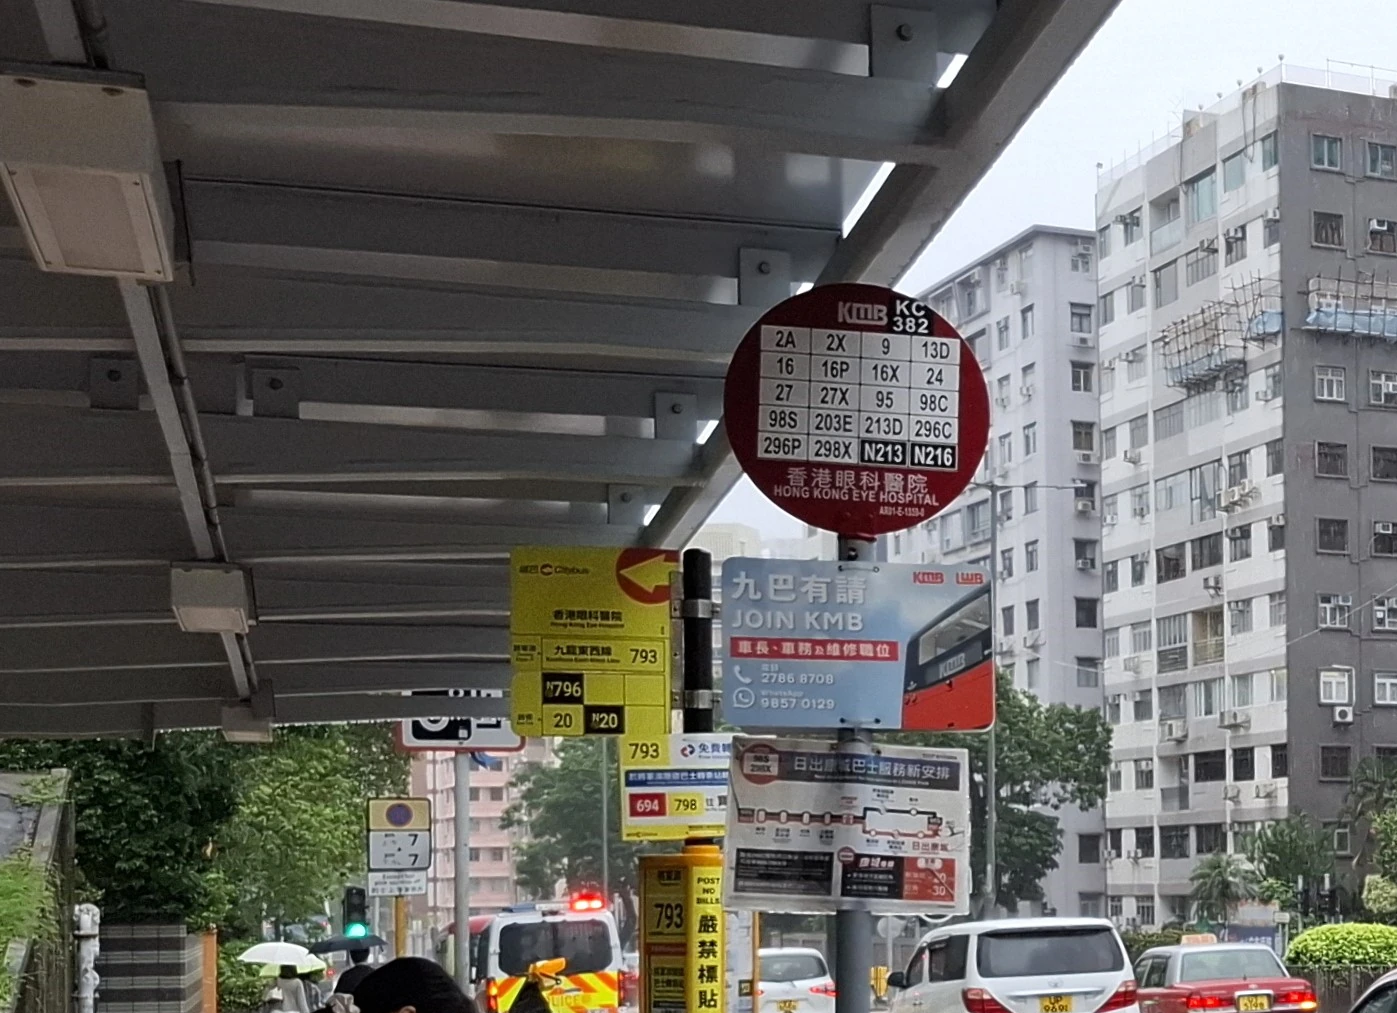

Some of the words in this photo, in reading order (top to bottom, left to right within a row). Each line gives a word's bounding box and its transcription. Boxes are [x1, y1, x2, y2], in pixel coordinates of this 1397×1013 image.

[838, 301, 888, 325] KMB
[895, 299, 927, 317] KC
[892, 316, 929, 334] 382
[775, 330, 796, 348] 2A
[826, 334, 846, 351] 2X
[881, 338, 890, 354] 9
[921, 342, 950, 359] 13D
[776, 356, 794, 374] 16
[821, 360, 850, 379] 16P
[871, 364, 900, 382] 16X
[926, 368, 943, 386] 24
[775, 383, 794, 402] 27
[820, 386, 849, 406] 27X
[875, 391, 894, 409] 95
[919, 394, 949, 413] 98C
[769, 410, 798, 429] 98S
[815, 413, 853, 433] 203E
[864, 418, 903, 437] 213D
[915, 420, 952, 439] 296C
[763, 436, 802, 455] 296P
[814, 440, 852, 460] 298X
[863, 444, 903, 464] N213
[914, 446, 953, 466] N216
[786, 467, 929, 494] 香港眼科醫院
[774, 485, 810, 498] HONG
[813, 488, 850, 501] KONG
[852, 490, 876, 502] EYE
[879, 491, 940, 507] HOSPITAL
[913, 571, 944, 584] KMB
[956, 572, 983, 585] LWB
[732, 571, 867, 604] 九巴有請
[732, 610, 794, 629] JOIN
[805, 611, 863, 631] KMB
[630, 648, 658, 664] 793
[738, 641, 892, 657] 車長、車務及維修職位
[762, 673, 795, 683] 2786
[800, 674, 834, 684] 8708
[762, 690, 804, 699] WhatsApp
[761, 699, 797, 709] 9857
[801, 699, 835, 709] 0129
[554, 713, 573, 728] 20
[629, 743, 660, 759] 793
[637, 799, 659, 812] 694
[674, 799, 697, 811] 798
[697, 877, 720, 885] POST
[654, 903, 684, 929] 793
[698, 915, 718, 1008] 嚴禁標貼
